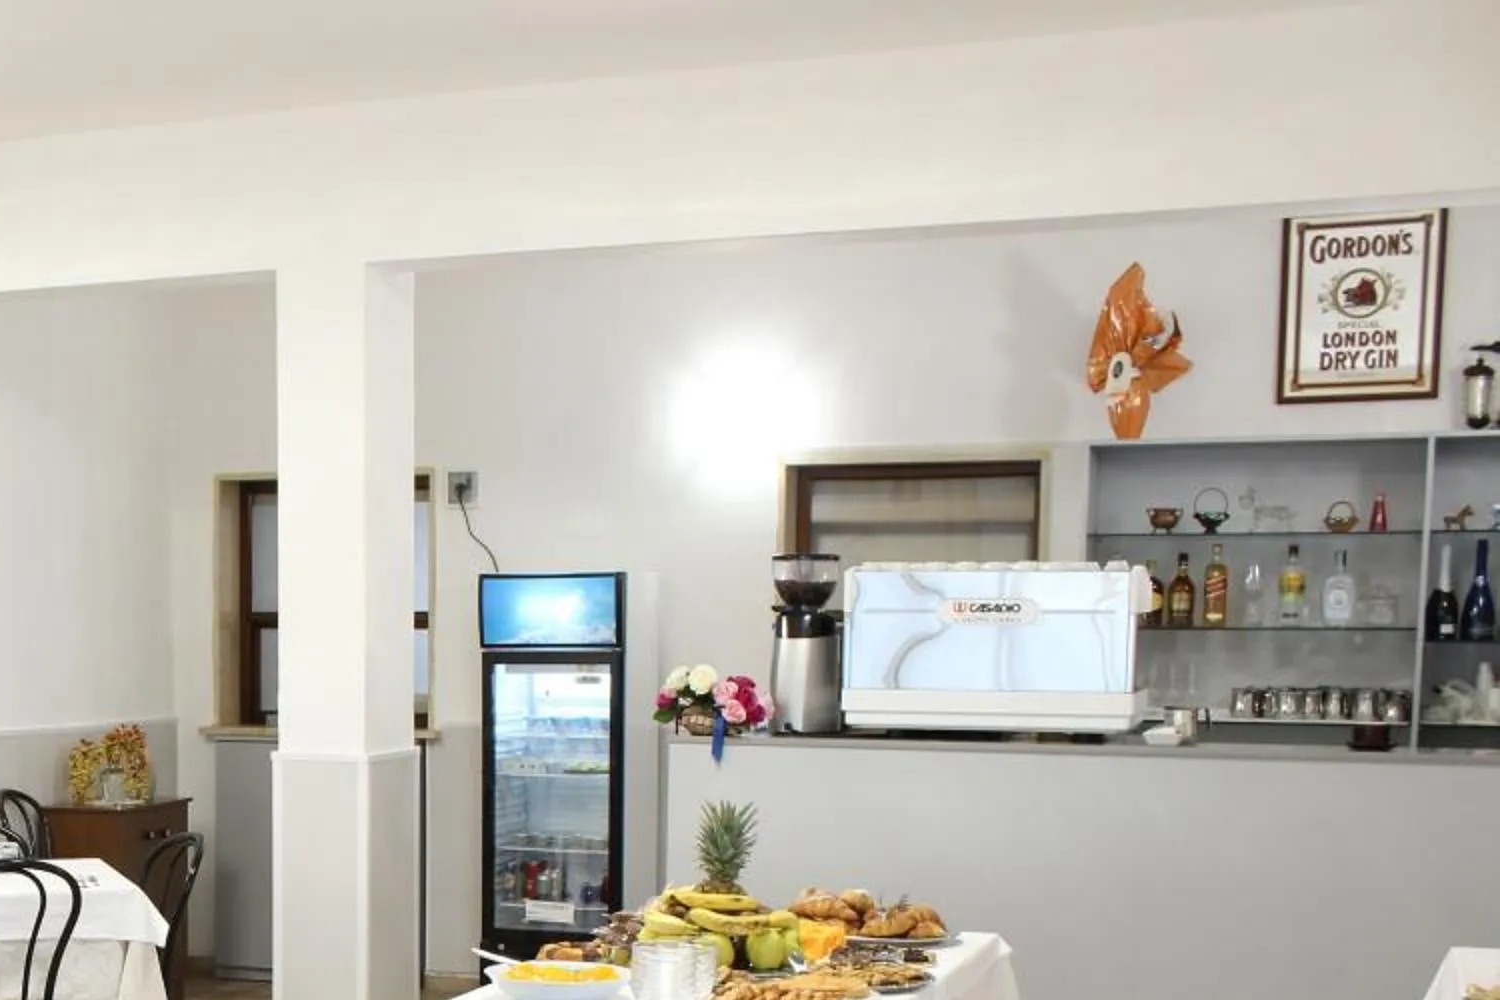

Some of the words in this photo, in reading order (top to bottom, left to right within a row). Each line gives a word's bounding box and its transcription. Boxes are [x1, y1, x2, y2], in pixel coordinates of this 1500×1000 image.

[1309, 229, 1413, 265] GORDON'S
[1322, 329, 1397, 349] LONDON
[1319, 350, 1360, 371] DRY
[1364, 349, 1398, 369] GIN
